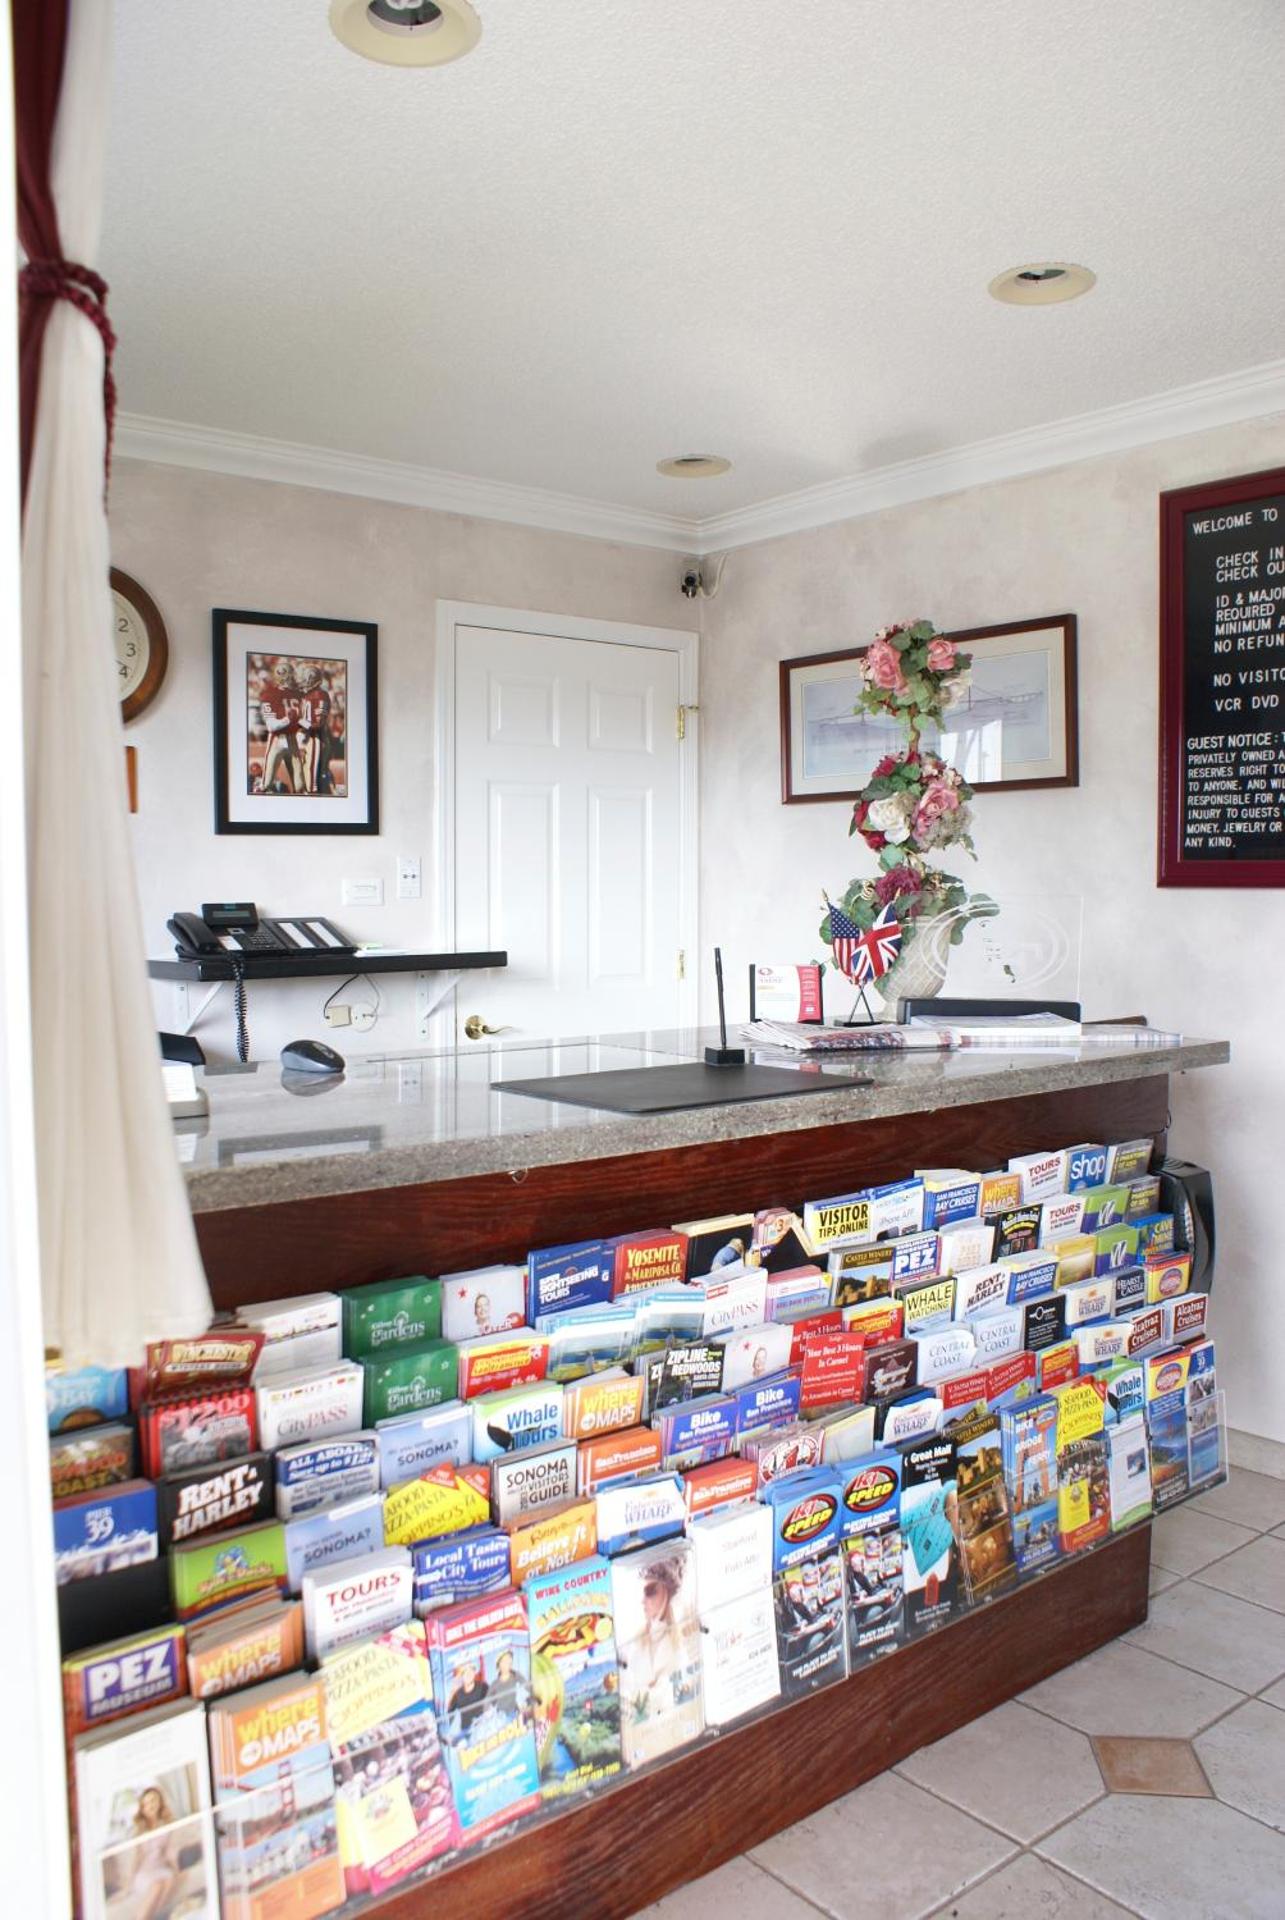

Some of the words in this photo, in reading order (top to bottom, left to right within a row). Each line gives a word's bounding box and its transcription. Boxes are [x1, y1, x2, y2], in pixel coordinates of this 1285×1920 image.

[1193, 512, 1252, 534] WELCOME
[1262, 508, 1278, 521] TO
[1216, 550, 1258, 568] CHECK
[1270, 546, 1284, 560] IN
[1216, 565, 1258, 582] CHECK
[1216, 595, 1229, 608] ID
[1236, 592, 1244, 605] &
[1216, 604, 1275, 622] REQUIRED
[118, 619, 129, 632] 2
[1215, 618, 1271, 635] MINIMUM
[126, 643, 136, 657] 3
[1214, 640, 1231, 653] NO
[118, 665, 129, 678] 4
[1214, 673, 1231, 686] NO
[1215, 698, 1241, 712] VCR
[1252, 695, 1279, 708] DVD
[1187, 736, 1224, 750] GUEST
[1188, 752, 1236, 764] PRIVATELY
[1242, 750, 1276, 761] OWNED
[1188, 766, 1234, 778] RESERVES
[1240, 764, 1268, 776] RIGHT
[1189, 782, 1199, 792] TO
[1247, 779, 1266, 790] AND
[1188, 793, 1251, 806] RESPONSIBLE
[1255, 793, 1273, 803] FOR
[1188, 809, 1222, 820] INJURY
[1226, 808, 1238, 818] TO
[1241, 808, 1280, 818] GUESTS
[1224, 822, 1266, 832] JEWELRY
[1269, 822, 1282, 832] OR
[1185, 837, 1203, 848] ANY
[1029, 1157, 1060, 1176] TOURS
[1070, 1154, 1105, 1180] shop
[819, 1204, 868, 1227] VISITOR
[1050, 1202, 1080, 1219] TOURS
[819, 1226, 836, 1238] TIPS
[840, 1219, 868, 1234] ONLINE
[628, 1244, 680, 1268] YOSEMITE
[895, 1248, 935, 1274] PEZ
[632, 1264, 670, 1281] MARIPOSA
[976, 1272, 1002, 1292] RENT
[907, 1284, 952, 1310] WHALE
[967, 1281, 1004, 1307] HARLEY
[371, 1319, 425, 1346] gardens
[667, 1348, 708, 1365] ZIPLINE
[672, 1361, 721, 1376] REDWOODS
[1116, 1376, 1141, 1396] Whale
[388, 1386, 442, 1411] gardens
[583, 1386, 637, 1412] where
[756, 1388, 784, 1406] Bike
[507, 1403, 558, 1430] Whale
[595, 1406, 635, 1429] MAPS
[690, 1411, 721, 1429] Bike
[398, 1440, 459, 1466] SONOMA?
[911, 1450, 933, 1464] Great
[934, 1444, 952, 1457] Mall
[506, 1458, 568, 1488] SONOMA
[529, 1472, 569, 1491] VISITORS
[180, 1464, 248, 1514] RENT
[530, 1483, 569, 1504] GUIDE
[848, 1482, 894, 1505] SPEED
[174, 1482, 264, 1540] HARLEY
[86, 1518, 114, 1542] 39
[784, 1508, 833, 1538] SPEED
[304, 1528, 371, 1564] SONOMA?
[426, 1546, 462, 1569] Local
[442, 1563, 467, 1579] City
[470, 1554, 507, 1572] Tours
[327, 1572, 400, 1607] TOURS
[536, 1584, 560, 1600] WINE
[564, 1568, 608, 1590] COUNTRY
[201, 1635, 282, 1680] where
[88, 1641, 172, 1702] PEZ
[226, 1652, 282, 1689] MAPS
[236, 1696, 318, 1743] where
[268, 1719, 320, 1758] MAPS
